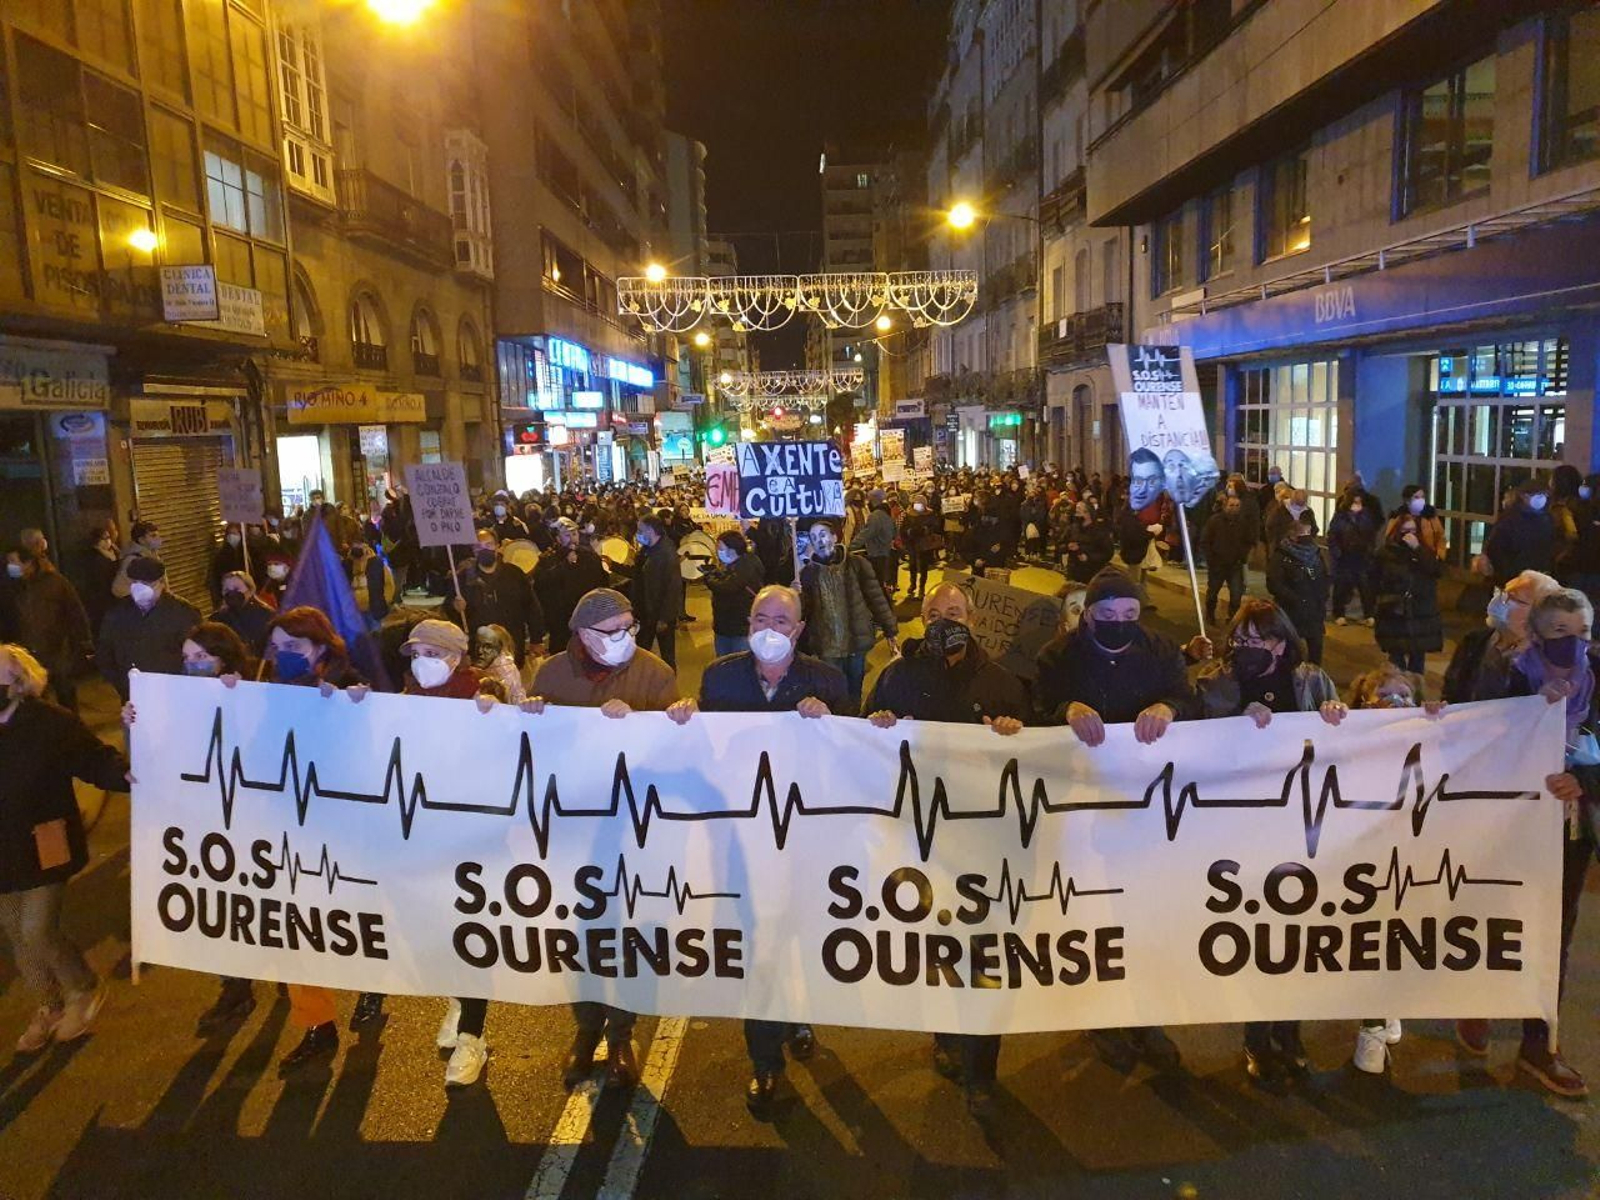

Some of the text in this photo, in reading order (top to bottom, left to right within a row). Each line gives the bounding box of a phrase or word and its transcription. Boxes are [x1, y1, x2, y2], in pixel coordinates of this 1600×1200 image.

[167, 283, 211, 295] DENTAL
[1315, 286, 1355, 323] BBVA
[30, 367, 107, 399] Galicia
[1132, 370, 1159, 381] S.O.S
[1134, 381, 1182, 392] OURENSE
[1158, 413, 1167, 429] A
[784, 478, 796, 492] A
[163, 827, 276, 889] S.O.S
[454, 862, 607, 920] S.O.S
[828, 865, 990, 926] S.O.S
[1205, 859, 1377, 917] S.O.S
[158, 882, 388, 960] OURENSE
[1198, 916, 1523, 977] OURENSE
[453, 922, 744, 979] OURENSE
[822, 926, 1125, 989] OURENSE
